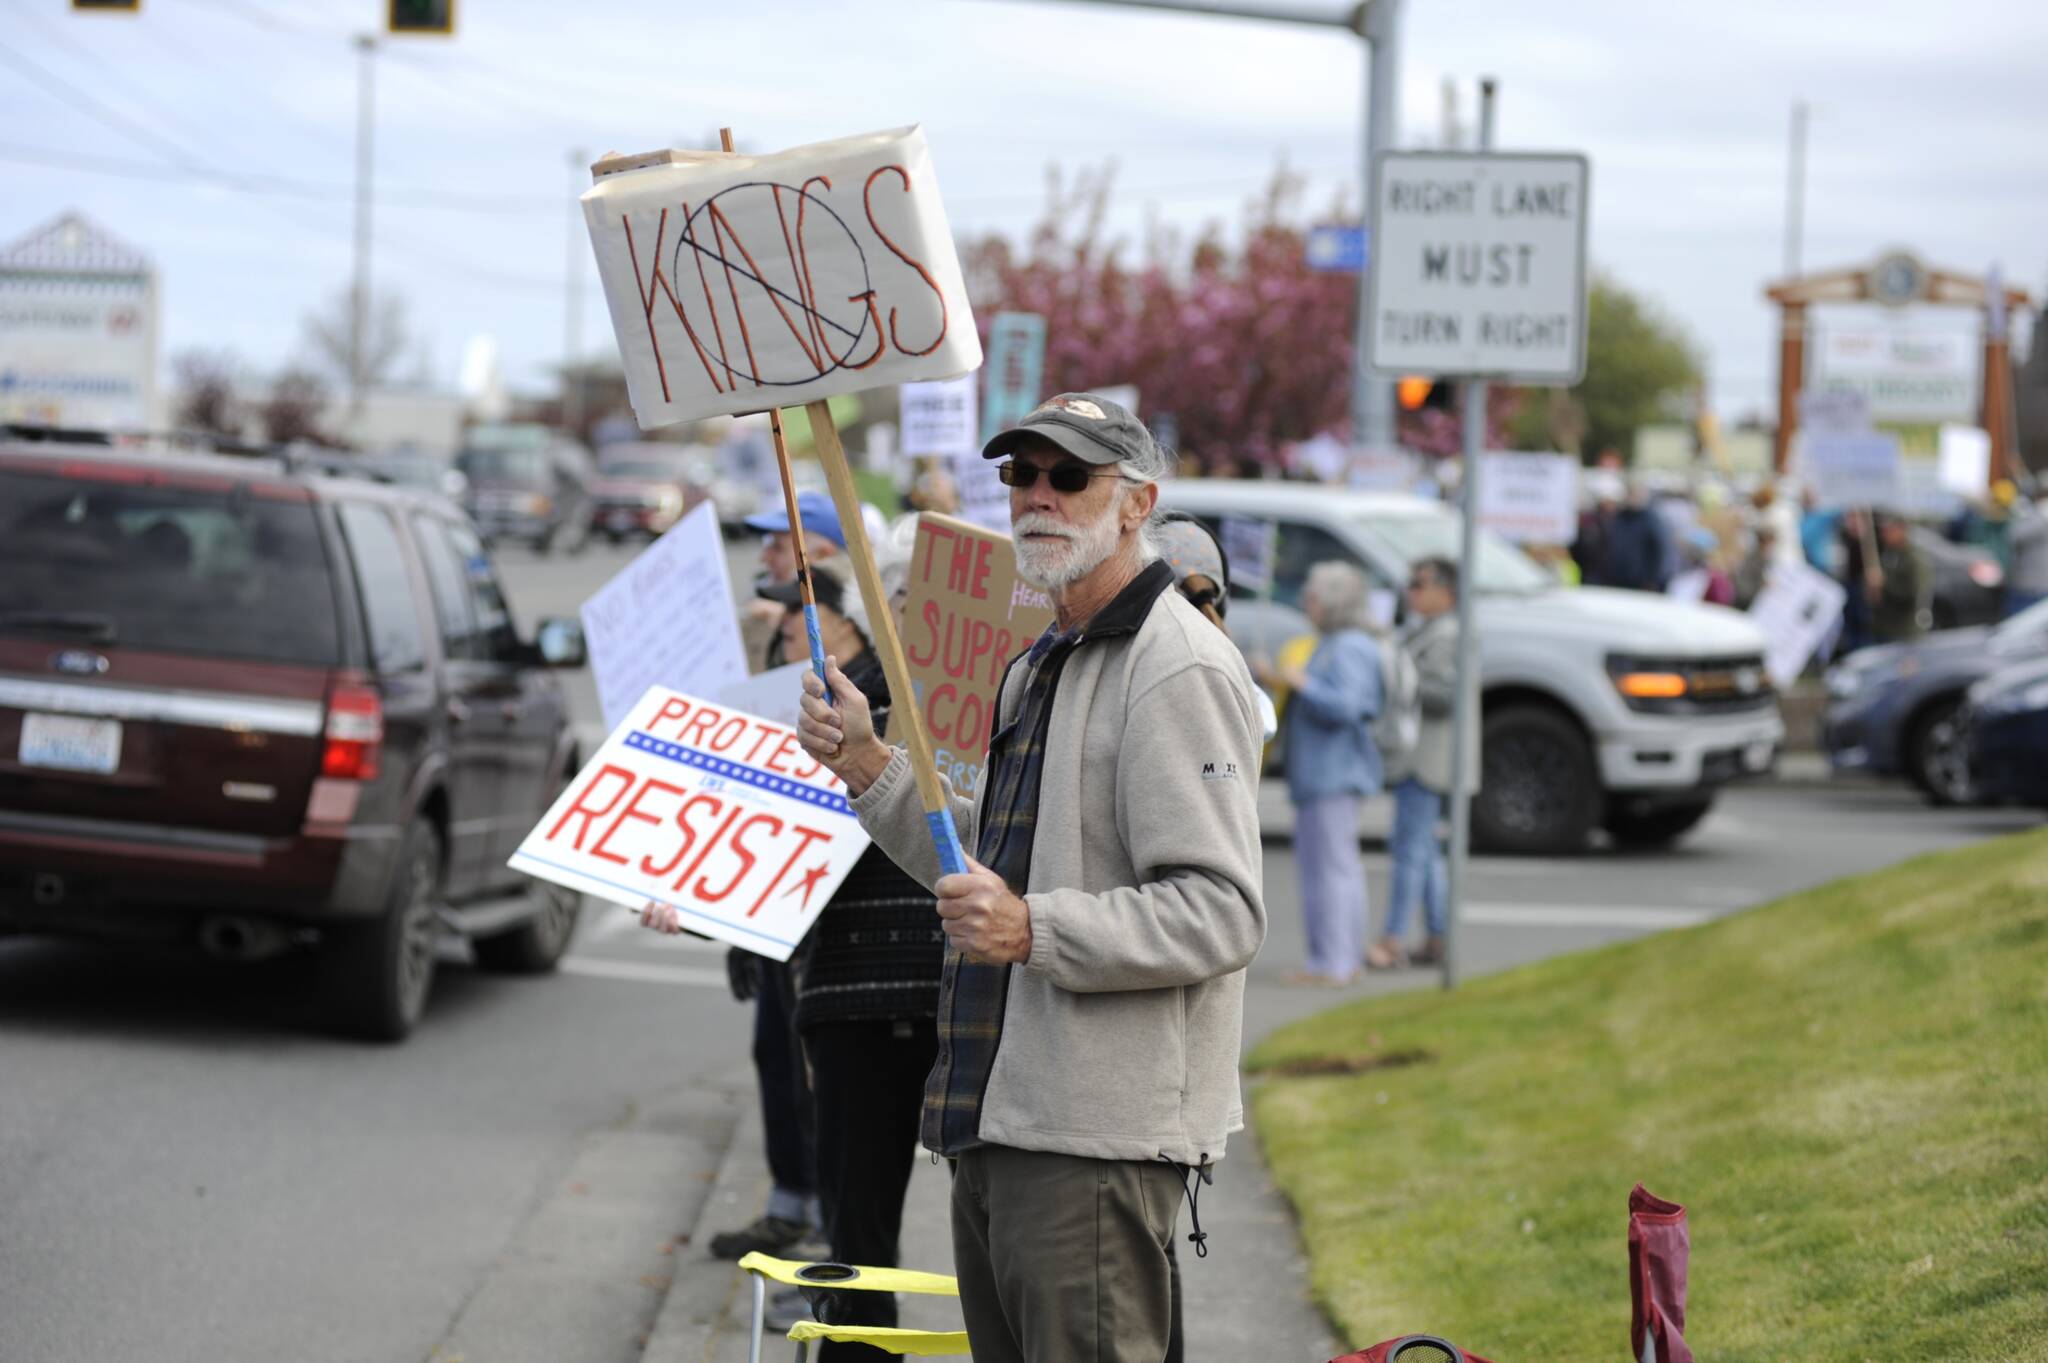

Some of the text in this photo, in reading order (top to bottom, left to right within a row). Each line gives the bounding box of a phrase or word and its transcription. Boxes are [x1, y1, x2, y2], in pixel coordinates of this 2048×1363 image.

[1389, 180, 1572, 219] RIGHT LANE
[622, 163, 947, 404] KINGS
[1422, 245, 1536, 286] MUST
[1383, 310, 1567, 348] TURN RIGHT
[919, 520, 994, 600] THE
[908, 599, 1037, 687] SUPR
[645, 697, 839, 788] PROTES
[545, 764, 832, 918] RESIST
